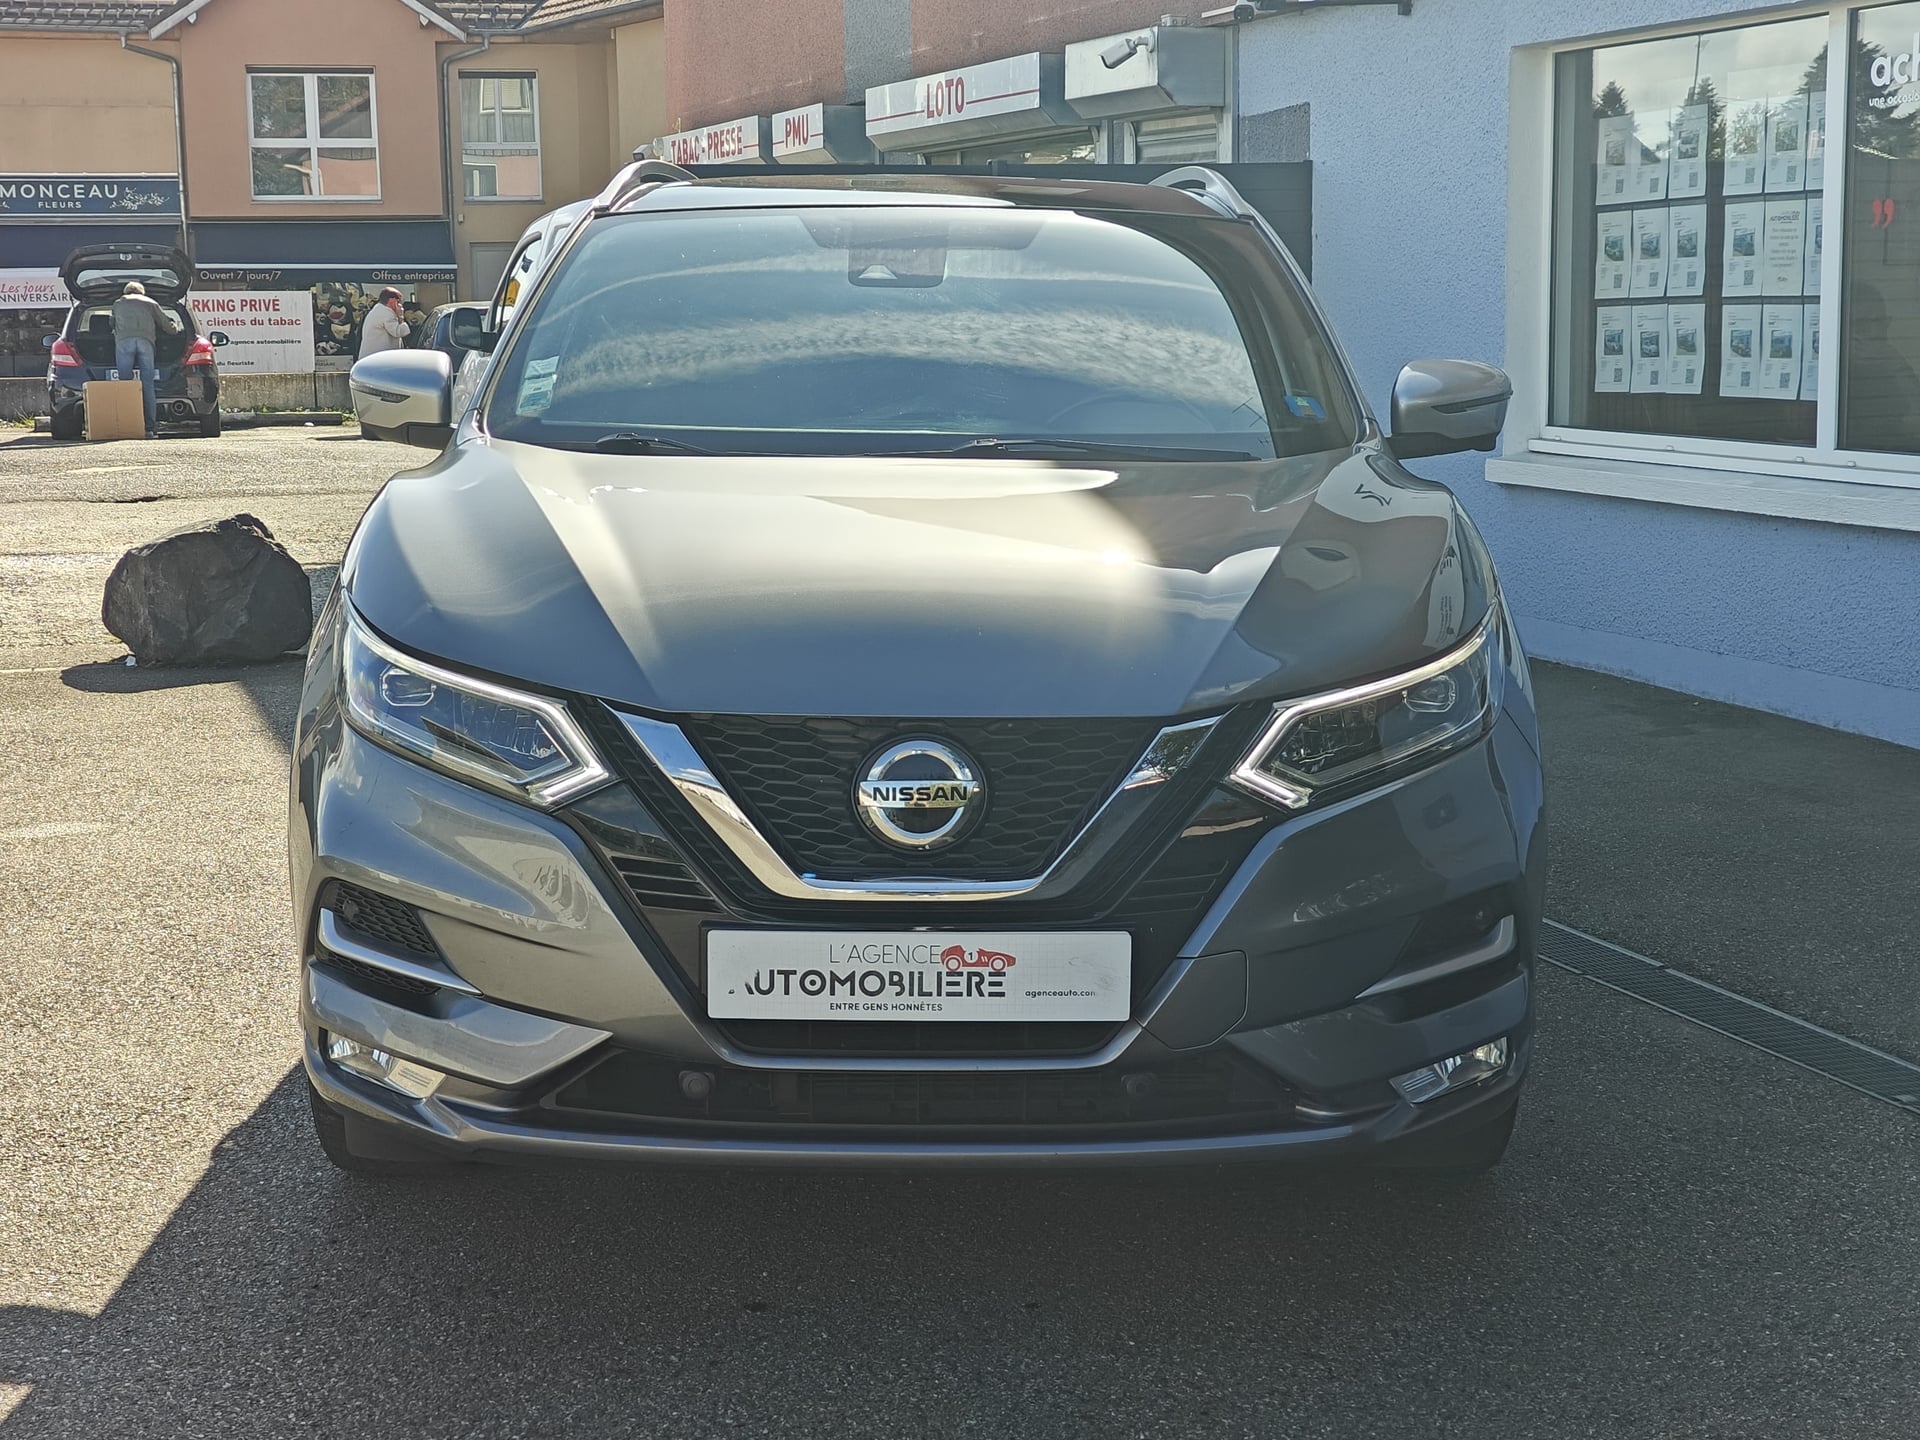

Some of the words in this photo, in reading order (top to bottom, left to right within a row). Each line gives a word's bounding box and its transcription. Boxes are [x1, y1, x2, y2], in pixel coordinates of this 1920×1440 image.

[926, 76, 965, 119] LOTO
[1869, 97, 1885, 107] une
[785, 114, 809, 149] PMU
[671, 135, 700, 164] TABAC
[707, 126, 743, 161] PRESSE
[0, 184, 118, 199] MONCEAU
[38, 201, 82, 209] FLEURS
[200, 271, 235, 280] Ouvert
[236, 271, 244, 280] 7
[246, 271, 281, 282] jours/7
[372, 270, 402, 280] Offres
[404, 271, 455, 282] entreprises
[1, 283, 21, 294] Les
[23, 281, 55, 297] jours
[240, 296, 280, 312] PRIVÉ
[206, 317, 247, 327] clients
[250, 317, 264, 326] du
[268, 317, 302, 326] tabac
[872, 786, 968, 802] NISSAN
[829, 943, 941, 964] L'AGENCE
[830, 1003, 859, 1011] ENTRE
[863, 1003, 888, 1011] GENS
[892, 1001, 943, 1011] HONNÊTES
